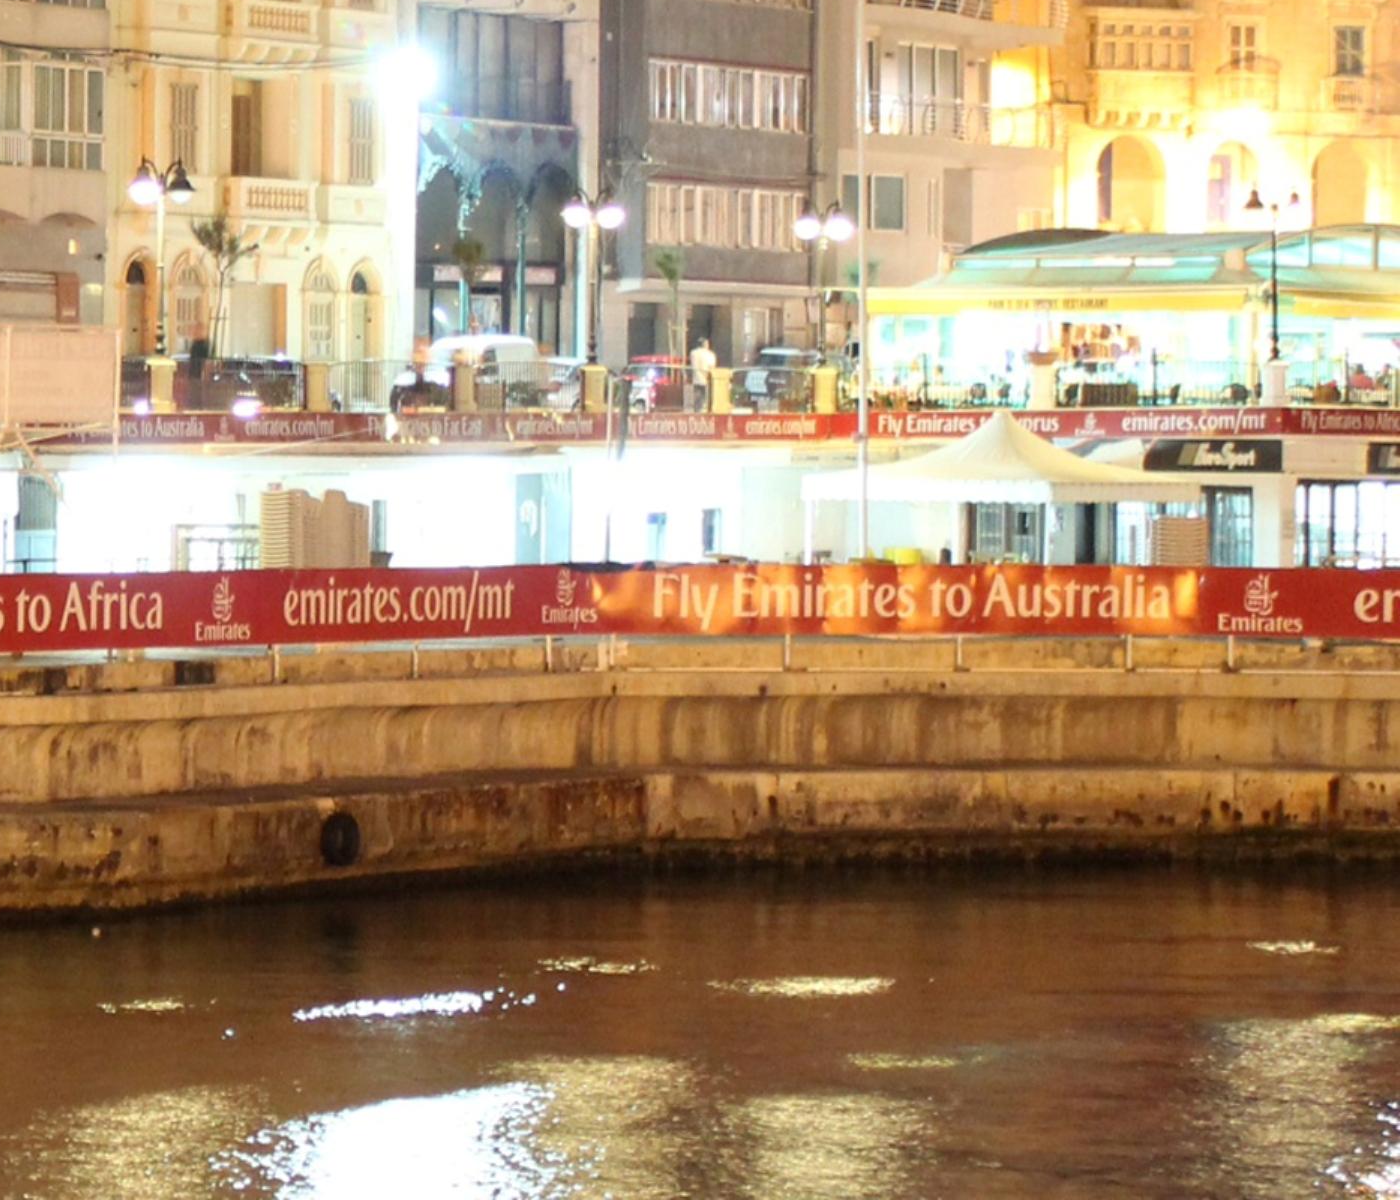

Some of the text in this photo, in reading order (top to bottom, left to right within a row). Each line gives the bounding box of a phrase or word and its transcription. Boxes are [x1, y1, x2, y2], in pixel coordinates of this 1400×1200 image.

[153, 415, 205, 437] Australia
[877, 414, 903, 437] Fly
[905, 413, 976, 434] Emirates
[1121, 409, 1267, 435] emirates.com/mt
[15, 589, 51, 633] to
[59, 580, 163, 633] Africa
[283, 570, 515, 633] emirates.com/mt
[653, 572, 1171, 630] Fly Emirates to Australia
[542, 604, 598, 629] Emirates
[1217, 612, 1303, 633] Emirates
[194, 620, 251, 643] Emirates
